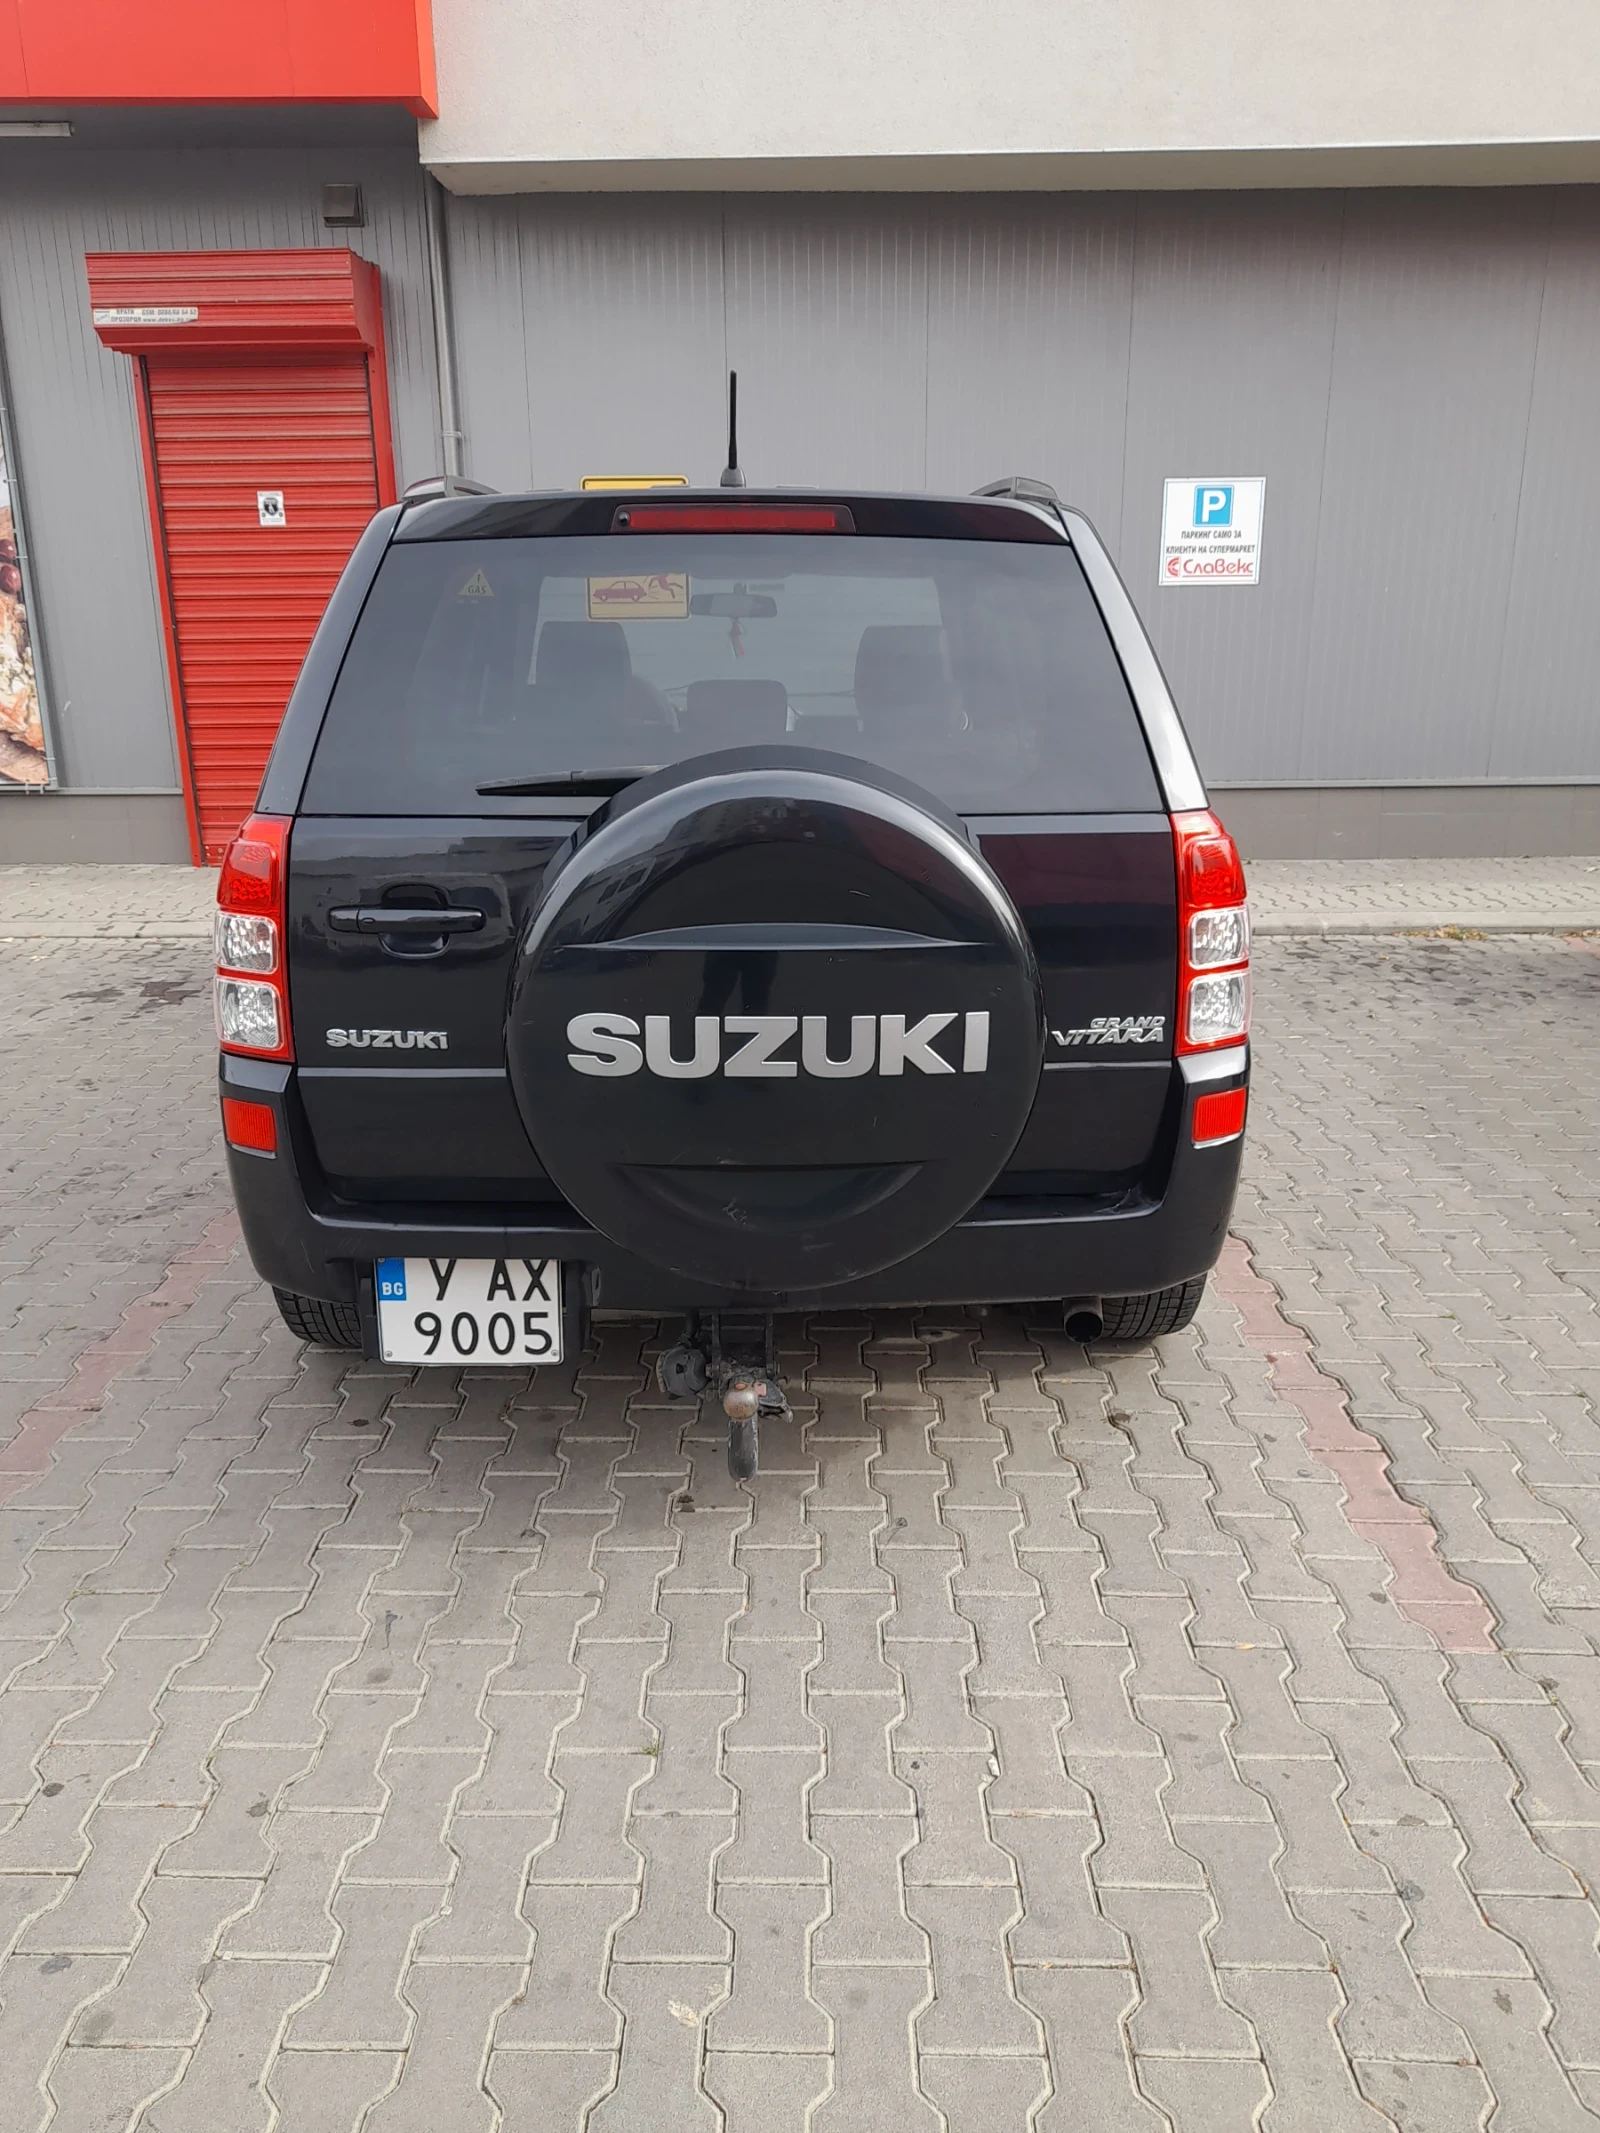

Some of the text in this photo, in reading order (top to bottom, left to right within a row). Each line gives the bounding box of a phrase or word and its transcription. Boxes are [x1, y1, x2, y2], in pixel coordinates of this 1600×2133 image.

[1201, 490, 1227, 522] P
[1181, 530, 1242, 539] ПАРКИНГ САМО ЗА
[1166, 544, 1256, 554] КЛИЕНТИ НА СУПЕРМАРКЕТ
[468, 585, 486, 594] GAS
[1090, 1016, 1166, 1029] GRAND
[326, 1028, 449, 1050] SUZUKI
[1051, 1027, 1163, 1046] VITARA
[566, 1012, 990, 1079] SUZUKI
[381, 1281, 404, 1296] BG
[414, 1311, 553, 1356] 9005
